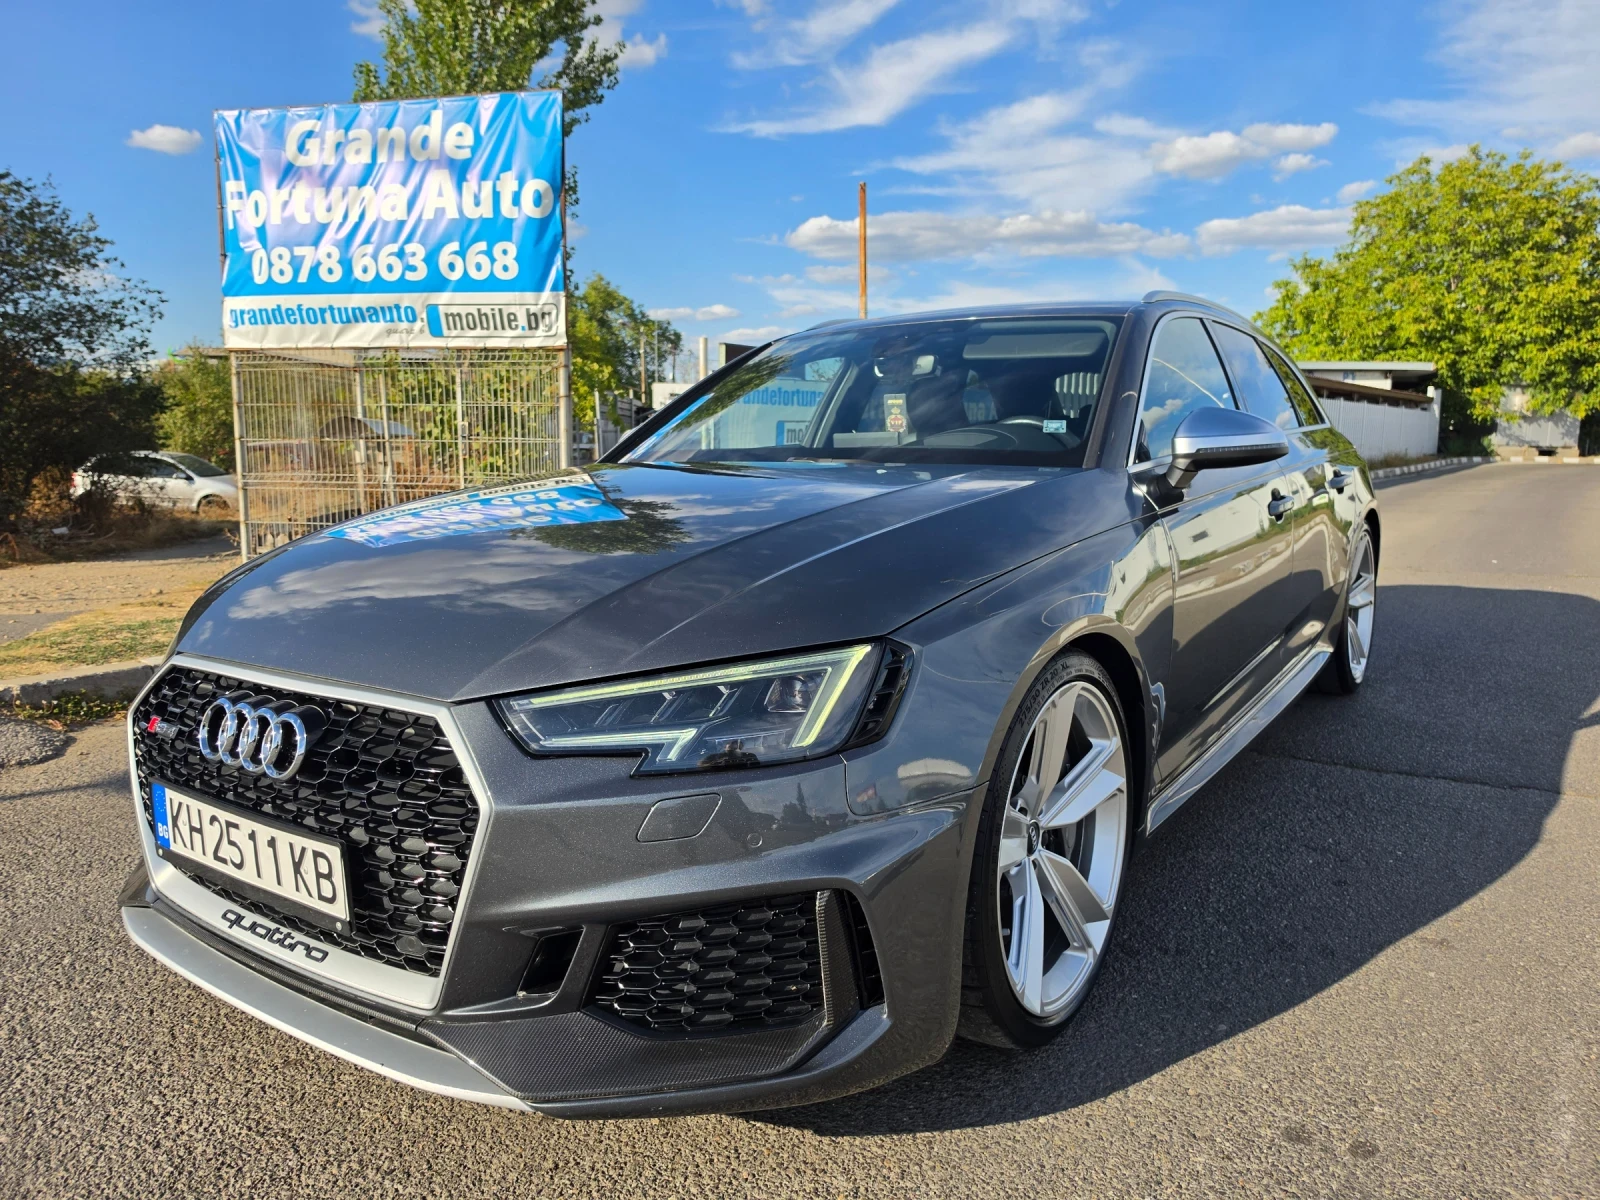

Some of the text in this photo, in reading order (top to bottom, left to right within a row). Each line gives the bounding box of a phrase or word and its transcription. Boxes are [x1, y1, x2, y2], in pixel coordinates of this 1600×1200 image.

[285, 109, 474, 167] Grande
[225, 169, 555, 230] Fortuna Auto
[252, 241, 519, 285] 0878 663 668
[444, 307, 553, 333] mobile.bg
[1018, 688, 1041, 728] 275/30
[1060, 661, 1070, 671] XL
[157, 822, 169, 840] BG
[221, 908, 329, 963] quattro
